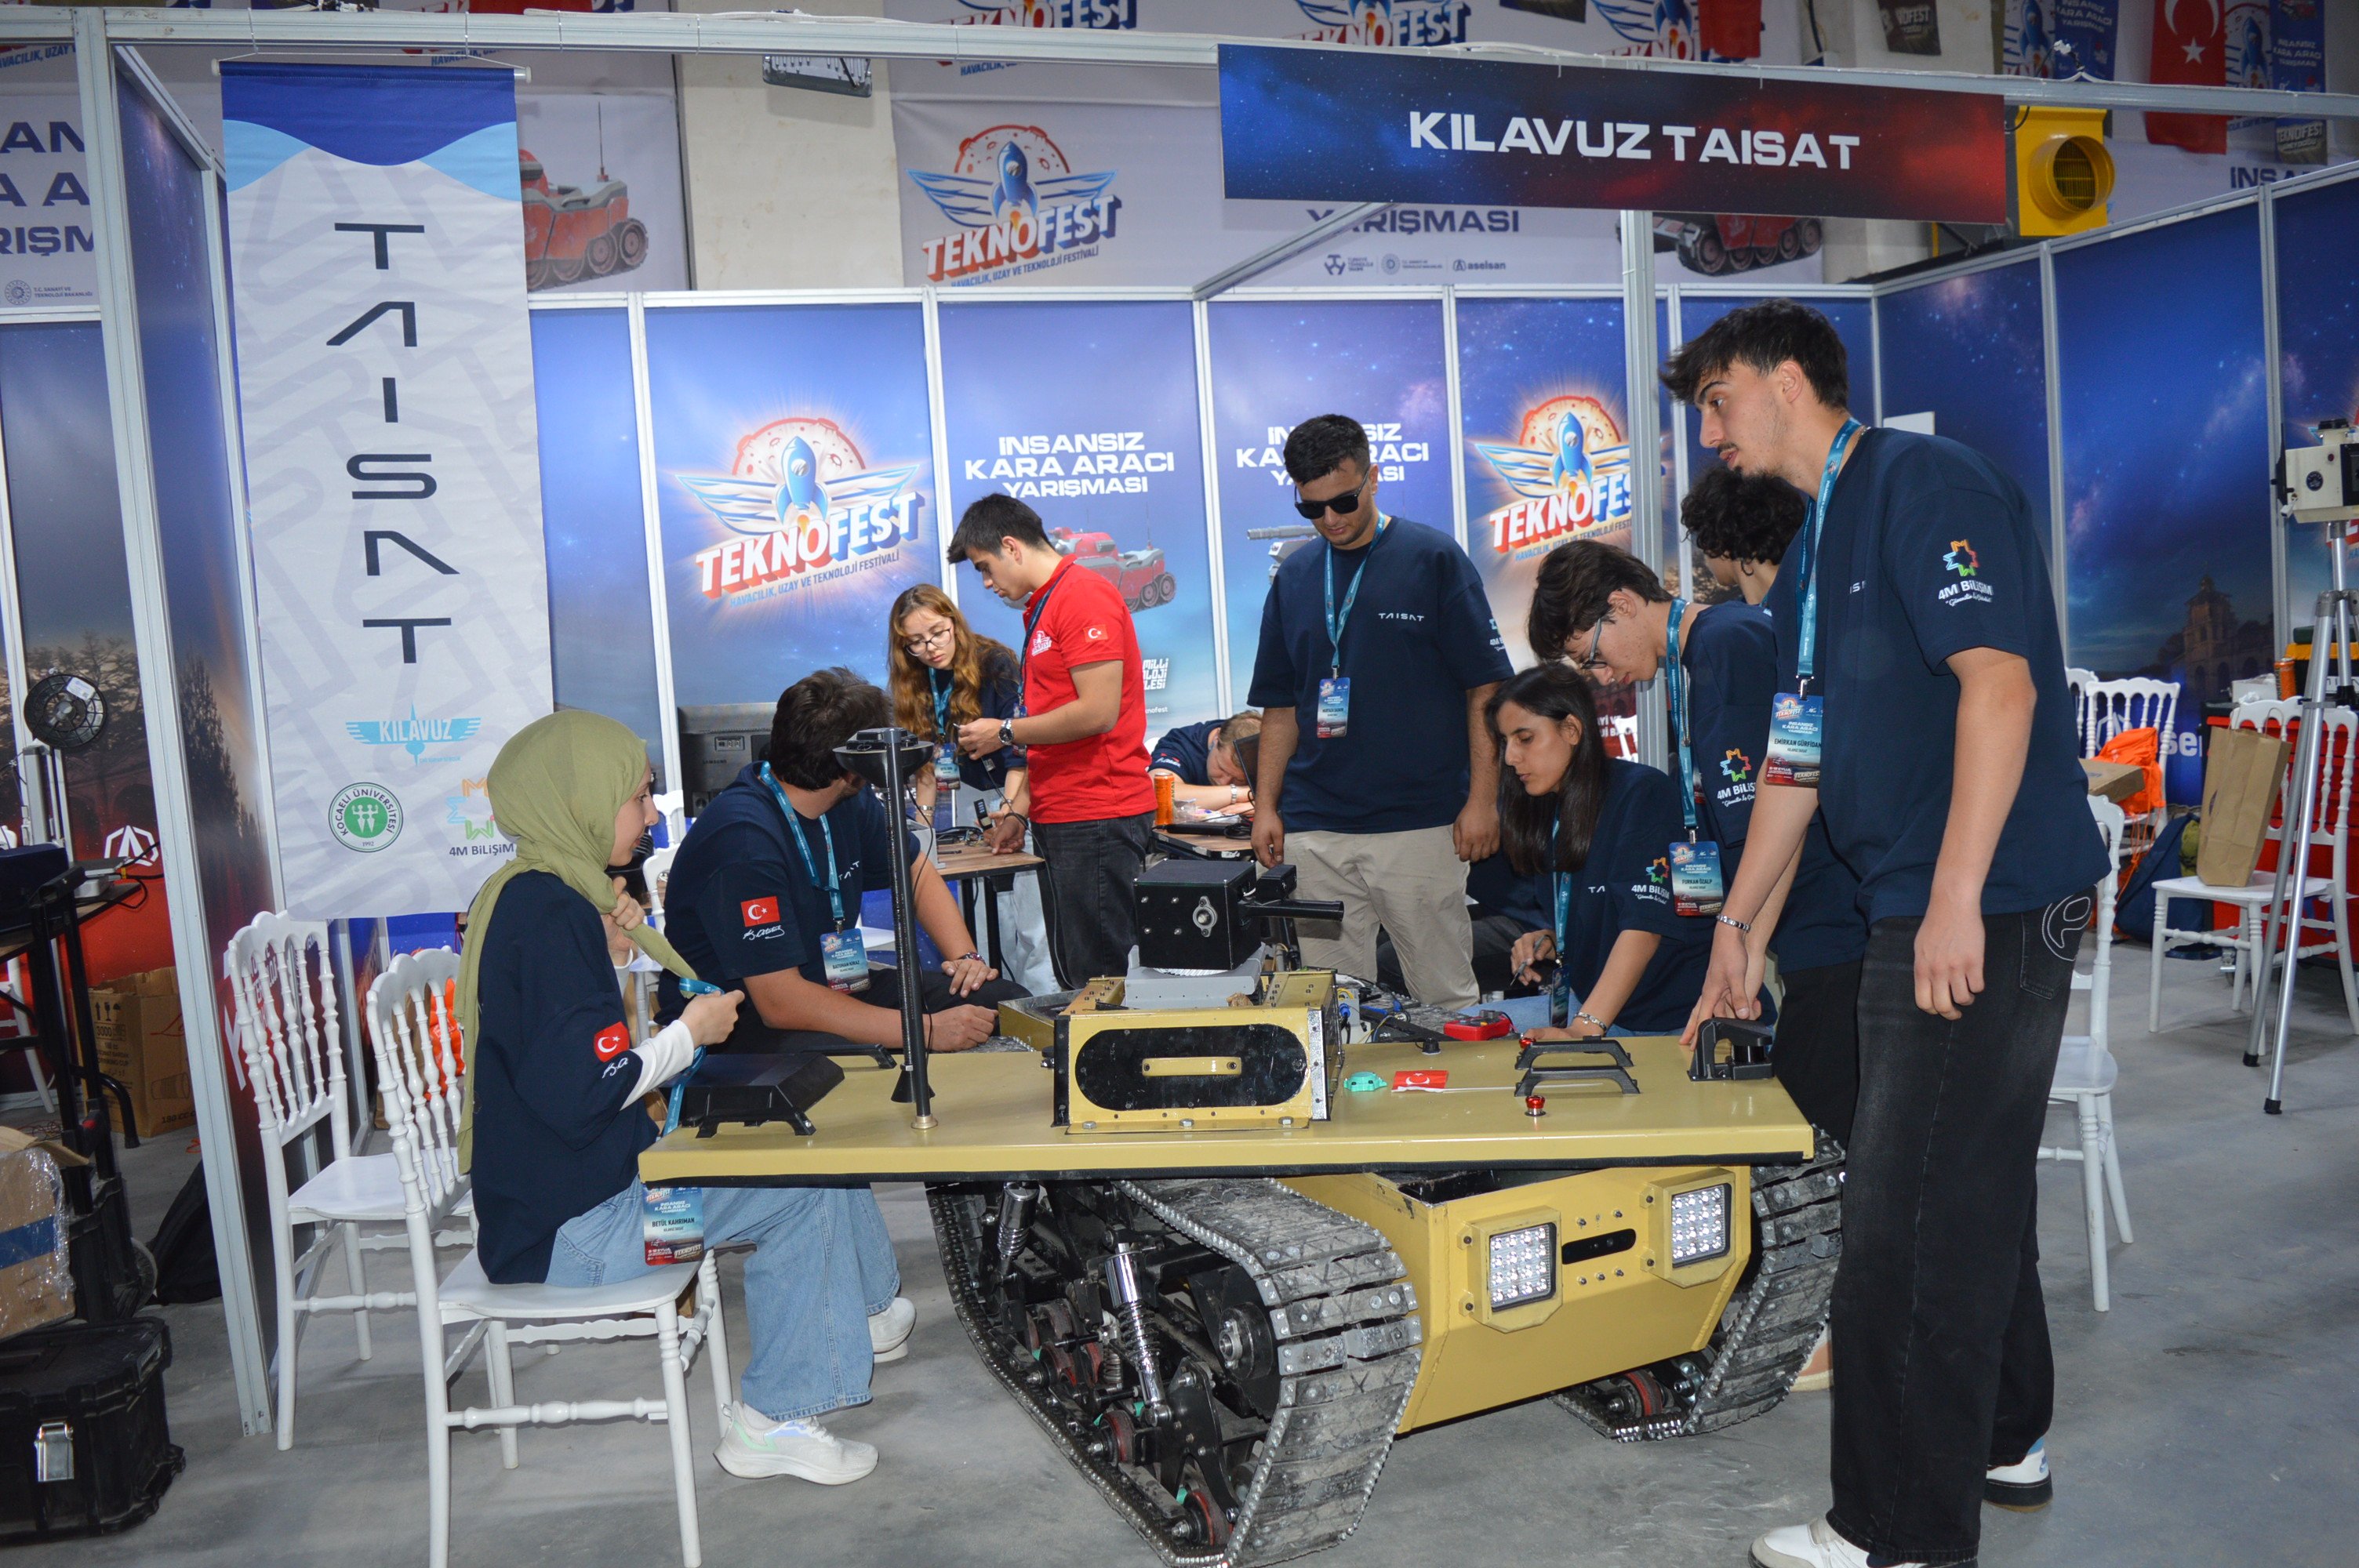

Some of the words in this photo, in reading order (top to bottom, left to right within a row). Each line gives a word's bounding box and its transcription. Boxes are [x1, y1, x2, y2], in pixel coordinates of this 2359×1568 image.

[45, 46, 69, 60] UZAY
[1410, 111, 1652, 161] KILAVUZ
[1662, 125, 1861, 170] TAISAT
[921, 194, 1121, 282] TEKNOFEST
[993, 269, 1011, 281] UZAY
[1012, 264, 1023, 274] VE
[1023, 253, 1063, 274] TEKNOLOJİ
[1063, 245, 1099, 263] FESTİVALİ
[1467, 260, 1506, 271] aselsan
[326, 223, 460, 663] TAISAT
[965, 456, 1065, 480] KARA
[1071, 452, 1175, 476] ARACI
[1002, 476, 1148, 499] YARIŞMASI
[695, 492, 925, 600] TEKNOFEST
[730, 586, 778, 608] HAVACILIK,
[778, 581, 799, 594] UZAY
[800, 576, 812, 587] VE
[812, 562, 858, 585] TEKNOLOJİ
[859, 550, 900, 572] FESTİVALİ
[1938, 583, 1958, 600] 4M
[1378, 612, 1425, 622] TAISAT
[378, 718, 453, 743] KILAVUZ
[1717, 787, 1732, 800] 4M
[335, 793, 352, 837] KOCAELİ
[352, 787, 397, 834] ÜNİVERSİTESİ
[449, 845, 468, 857] 4M
[1631, 884, 1647, 893] 4M
[652, 1219, 667, 1228] BETÜL
